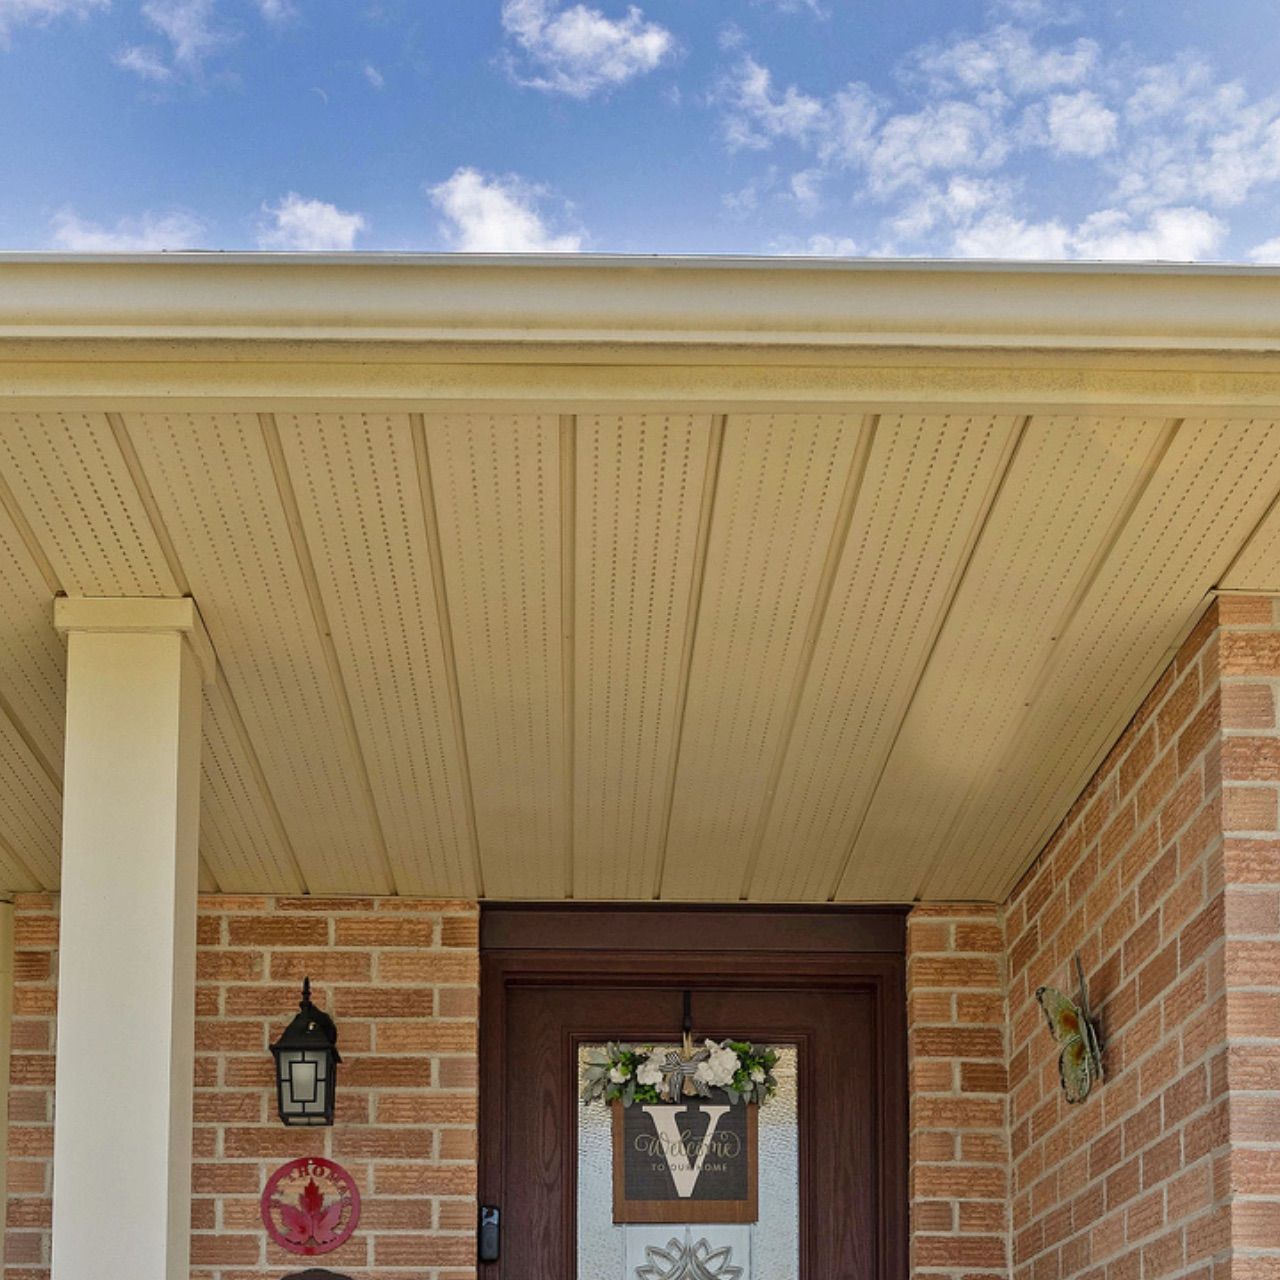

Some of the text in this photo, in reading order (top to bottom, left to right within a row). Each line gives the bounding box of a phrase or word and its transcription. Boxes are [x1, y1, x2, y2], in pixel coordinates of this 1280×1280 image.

[634, 1129, 741, 1159] Welcome
[641, 1105, 731, 1198] V
[651, 1162, 728, 1172] TO OUR HOME
